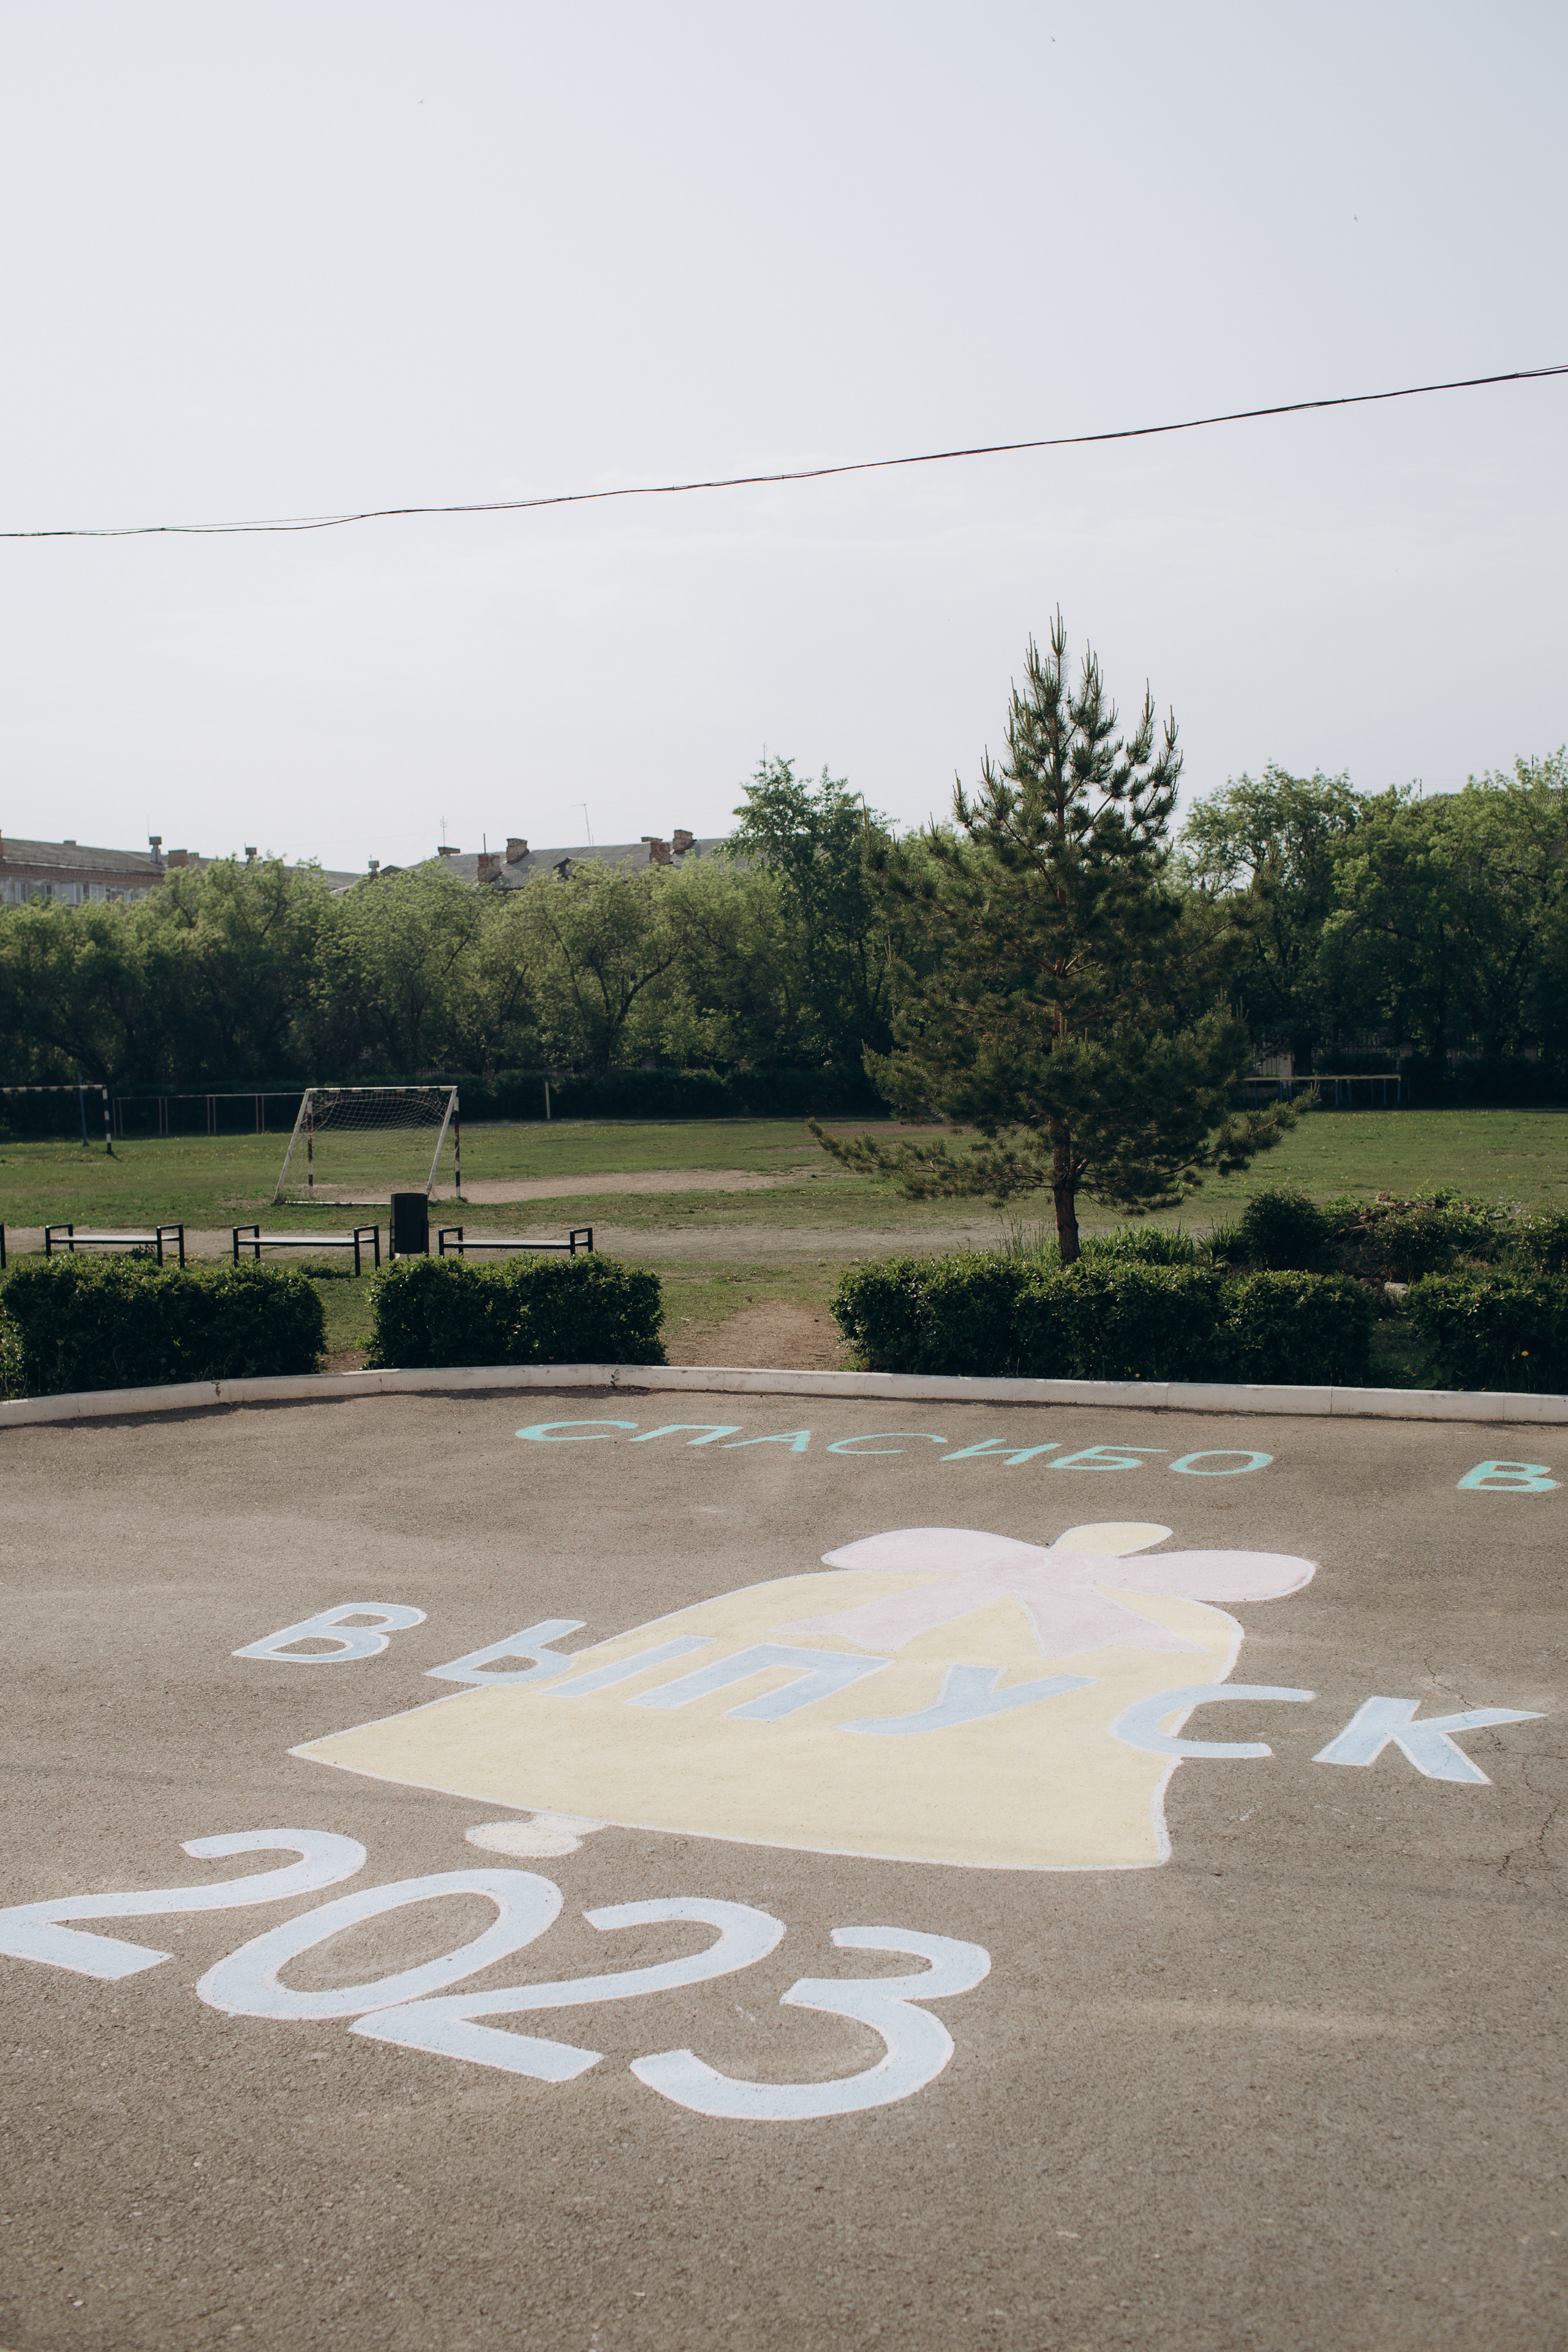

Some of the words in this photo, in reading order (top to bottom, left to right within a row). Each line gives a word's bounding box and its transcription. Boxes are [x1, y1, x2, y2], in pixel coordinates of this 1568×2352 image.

[515, 1420, 1275, 1475] СПАСИБО
[232, 1602, 1547, 1785] ВЫПУСК
[0, 1828, 992, 2121] 2023
